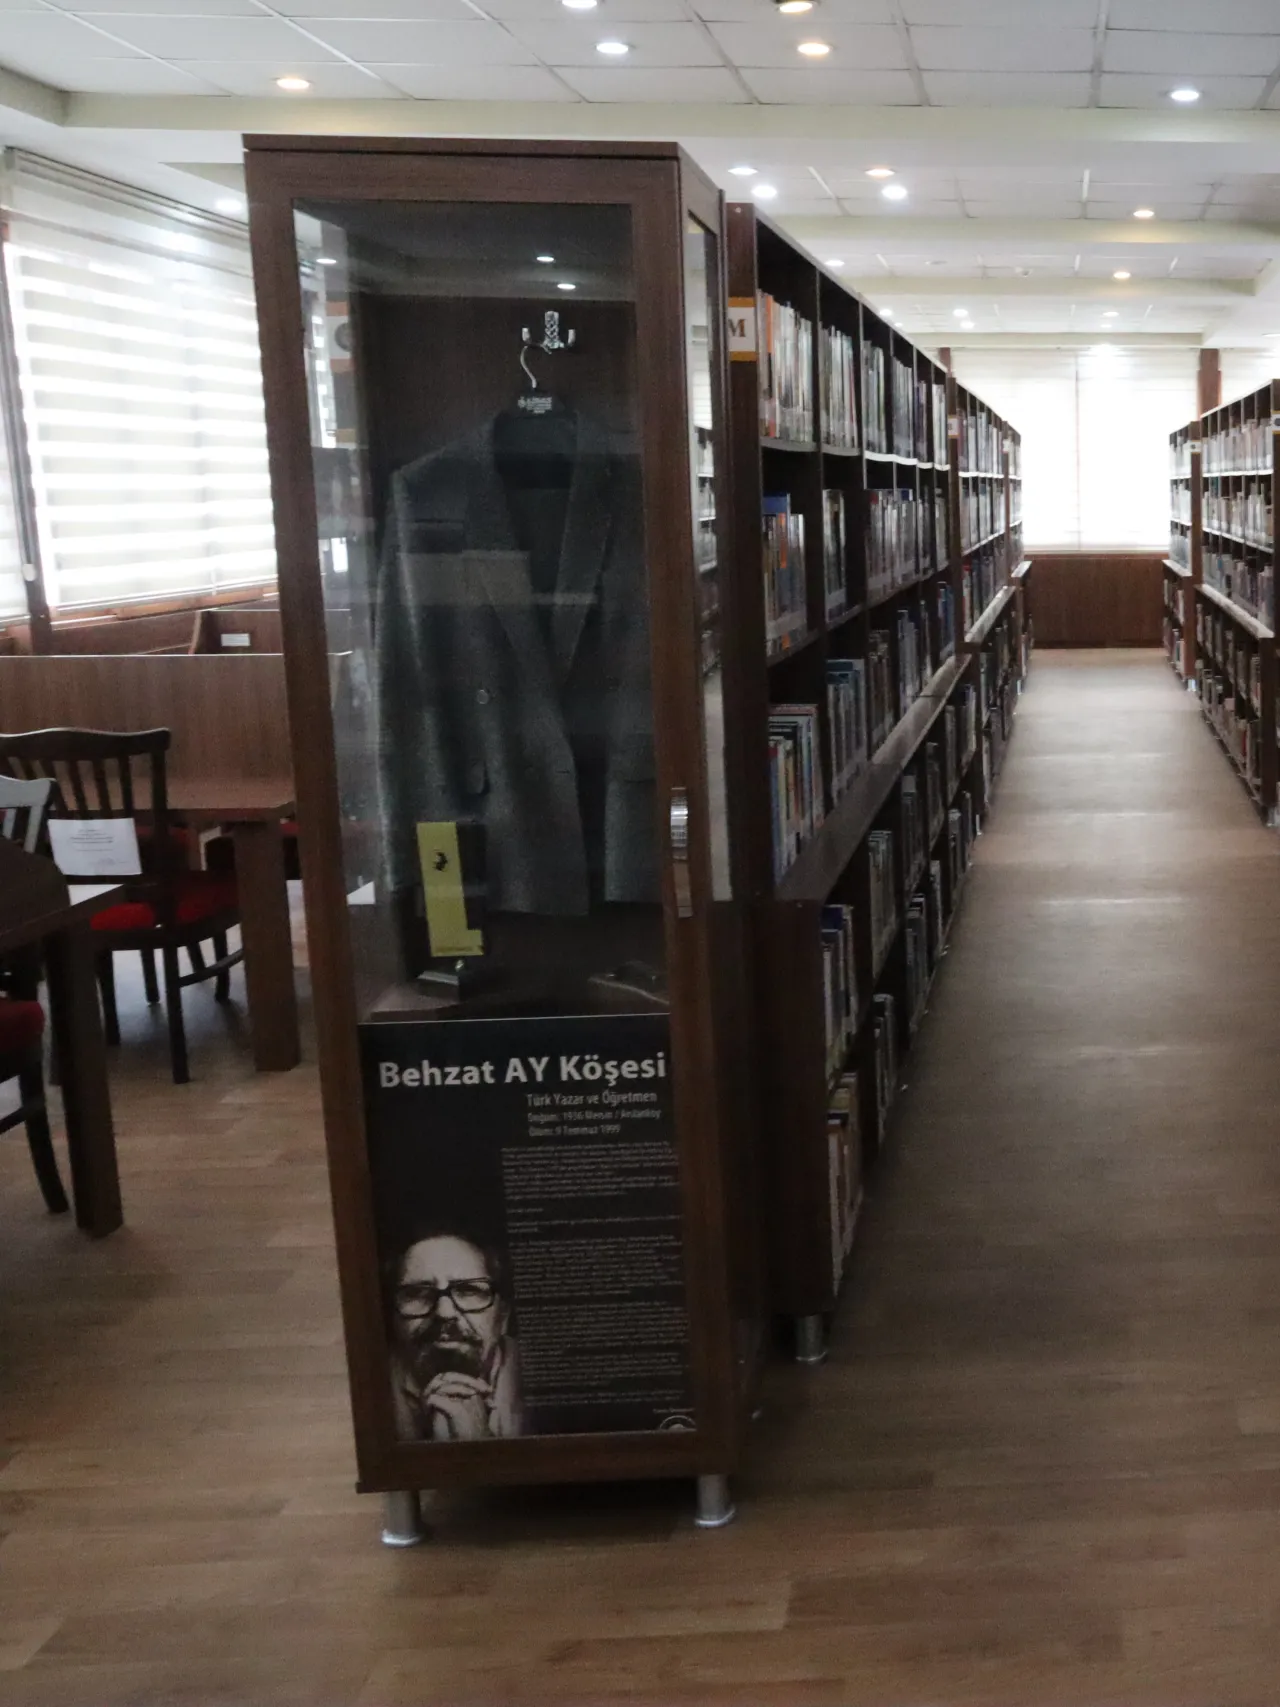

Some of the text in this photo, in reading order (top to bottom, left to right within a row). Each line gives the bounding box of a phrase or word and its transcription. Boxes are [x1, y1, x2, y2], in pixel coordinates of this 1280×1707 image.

[727, 318, 746, 338] M
[378, 1051, 668, 1088] Behzat AY Köşesi
[526, 1089, 658, 1107] Türk Yazar ve Öğretmen
[562, 1125, 599, 1136] Temmuz
[600, 1123, 621, 1134] 1999
